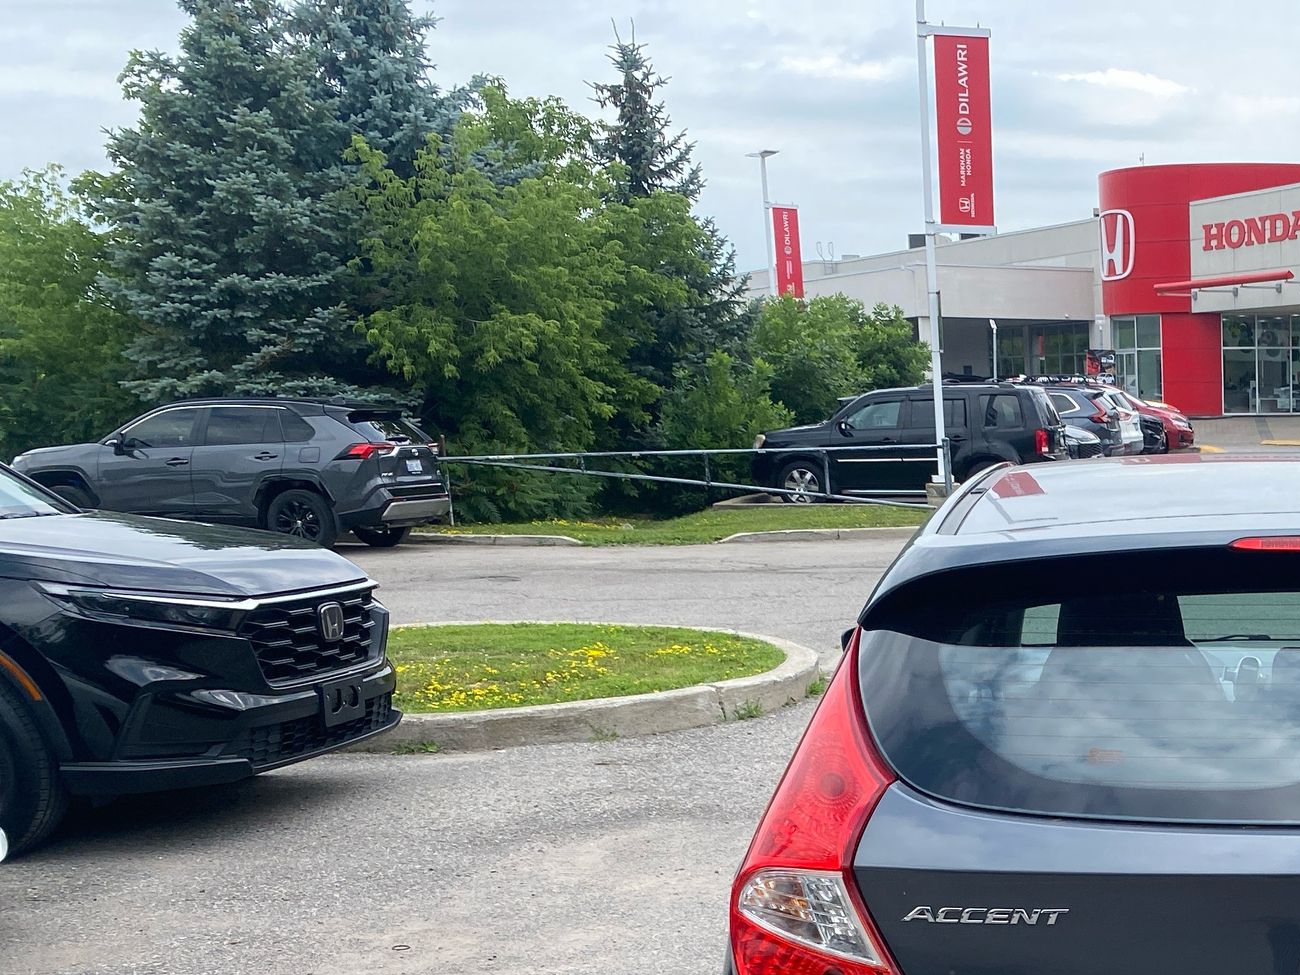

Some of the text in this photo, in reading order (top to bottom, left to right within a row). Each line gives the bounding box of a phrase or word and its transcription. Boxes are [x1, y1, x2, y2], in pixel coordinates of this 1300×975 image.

[957, 44, 970, 114] DILAWRI
[783, 211, 791, 245] DILAWRI
[900, 906, 1070, 925] ACCENT
